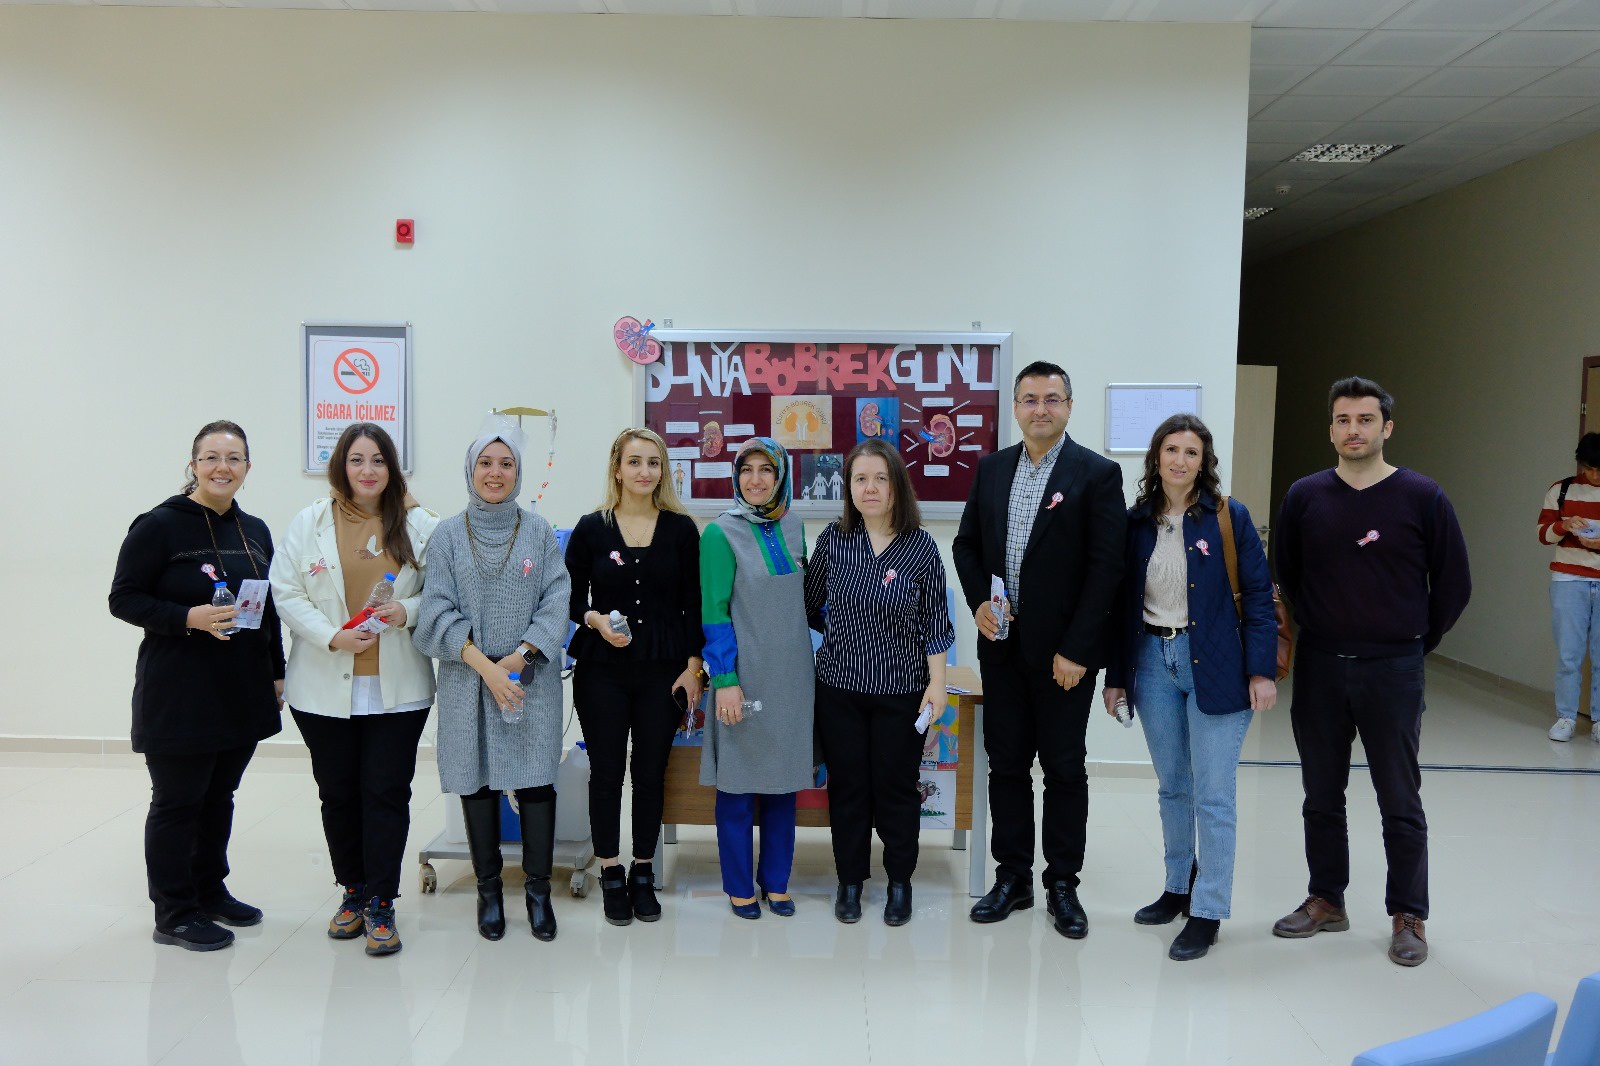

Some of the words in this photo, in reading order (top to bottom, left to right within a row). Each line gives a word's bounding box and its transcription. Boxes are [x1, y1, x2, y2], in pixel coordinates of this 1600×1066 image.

[744, 343, 897, 396] BÖBREK
[316, 400, 352, 420] SİGARA
[355, 400, 396, 424] İÇİLMEZ
